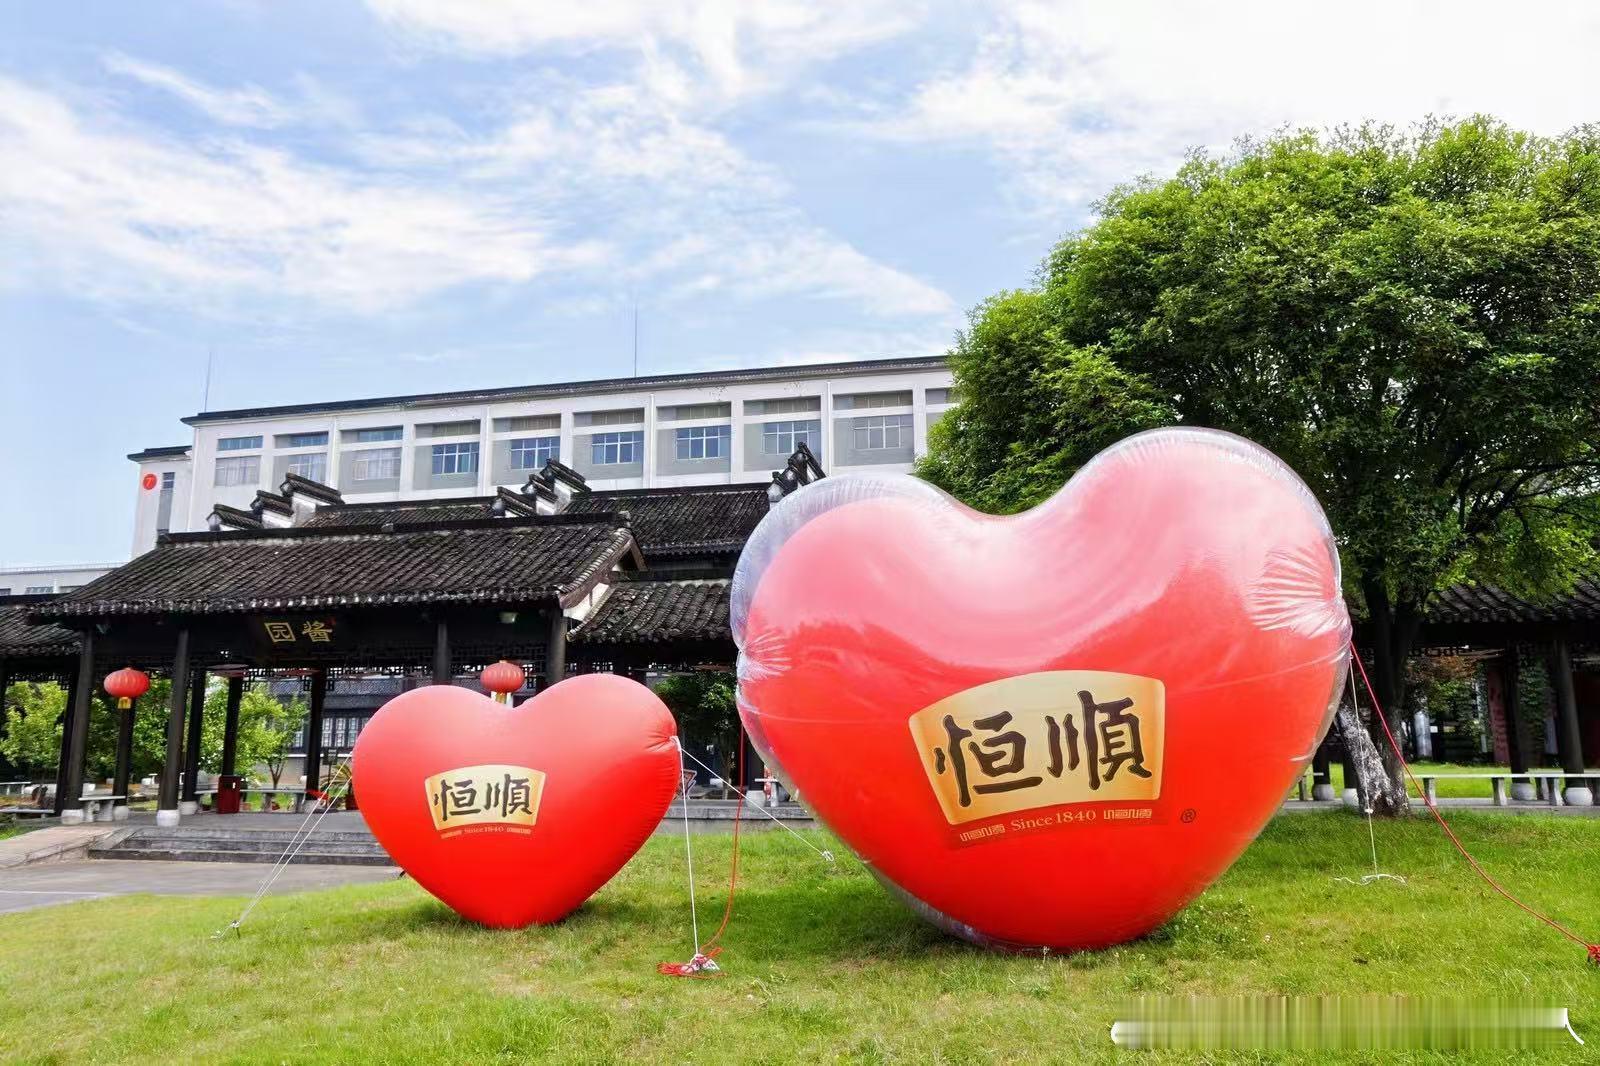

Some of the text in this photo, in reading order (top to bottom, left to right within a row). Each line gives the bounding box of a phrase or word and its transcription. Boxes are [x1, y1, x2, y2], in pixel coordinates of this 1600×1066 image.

[934, 690, 1153, 808] 恒順
[434, 773, 533, 821] 恒順
[1011, 810, 1097, 832] Since 1840
